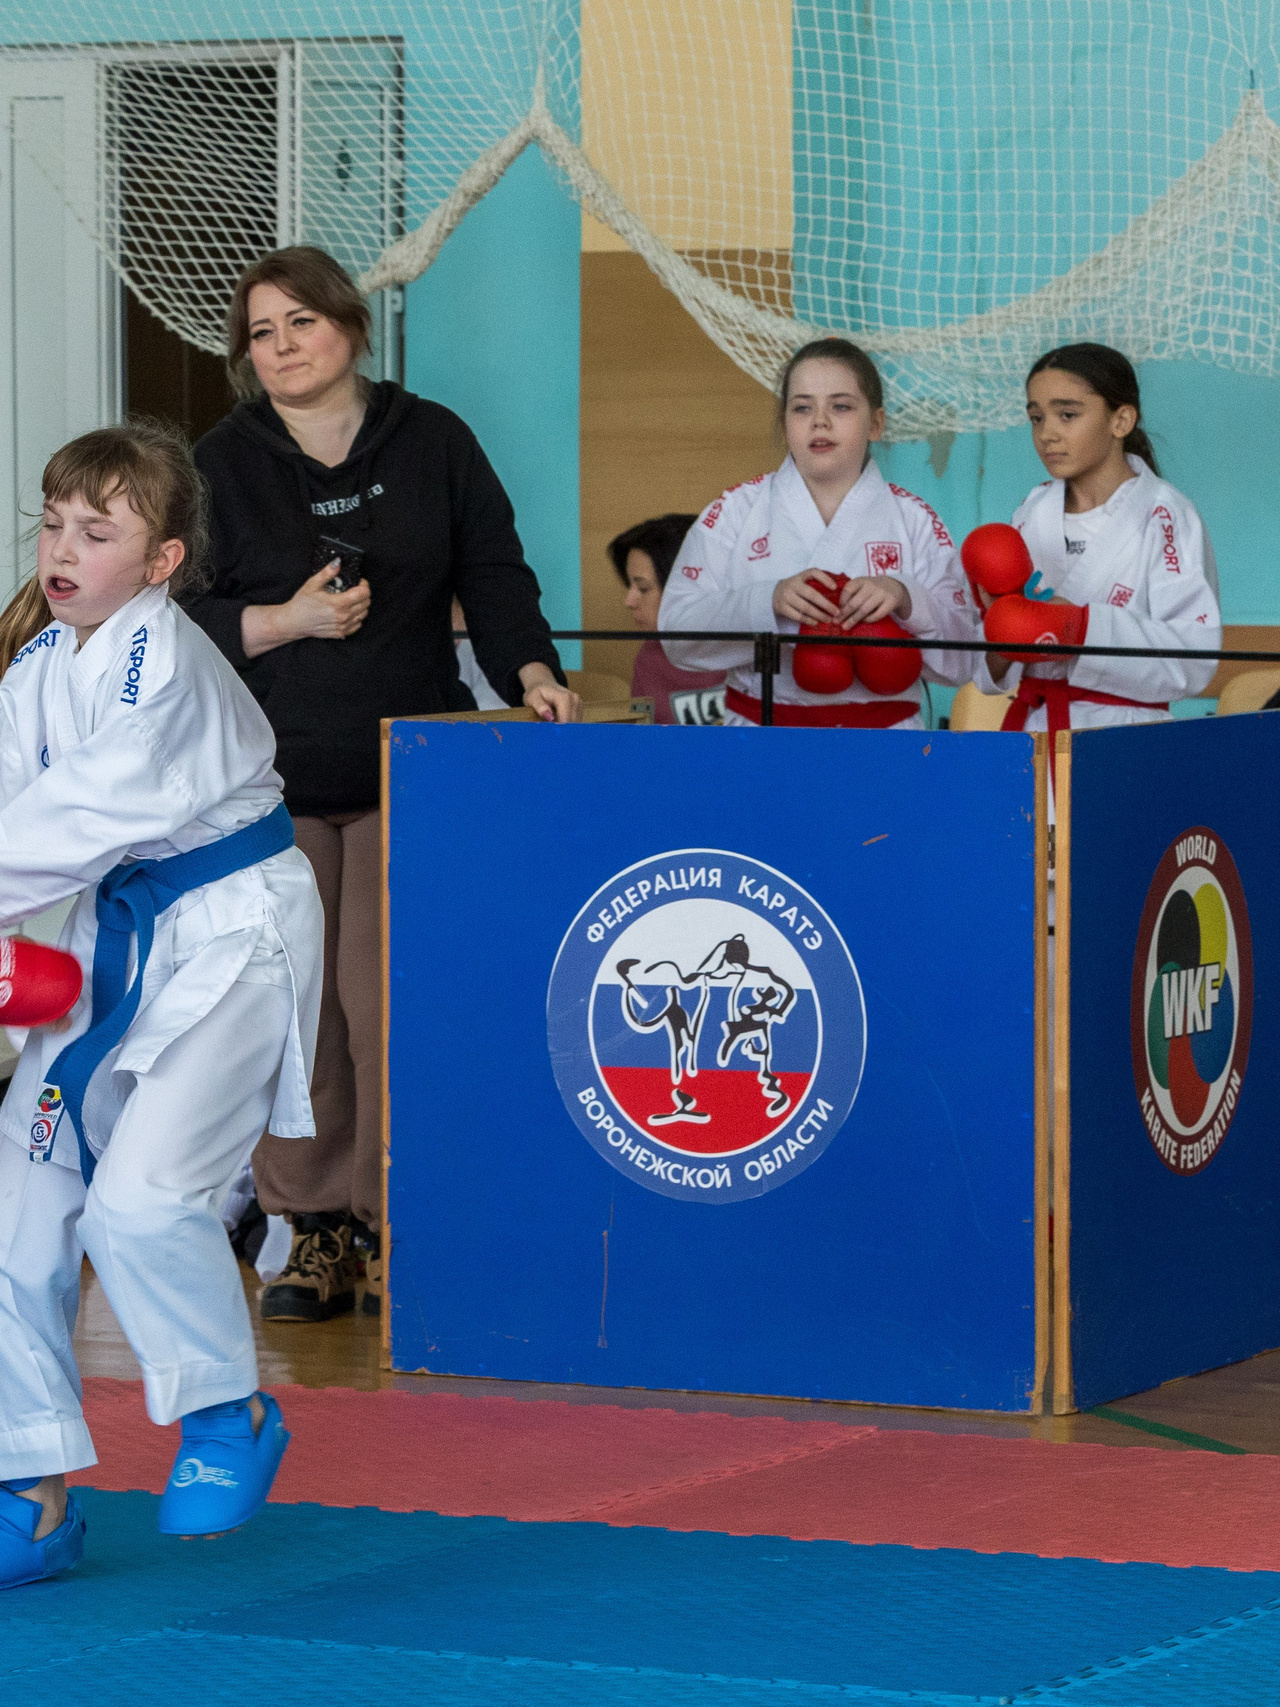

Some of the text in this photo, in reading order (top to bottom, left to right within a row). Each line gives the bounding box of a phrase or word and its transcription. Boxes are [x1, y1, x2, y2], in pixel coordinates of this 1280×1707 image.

[1175, 834, 1217, 867] WORLD
[586, 866, 824, 951] ФЕДЕРАЦИЯ КАРАТЭ
[1161, 962, 1220, 1039] WKF
[577, 1086, 834, 1189] ВОРОНЕЖСКОЙ ОБЛАСТИ
[1140, 1068, 1241, 1169] KARATE FEDERATION
